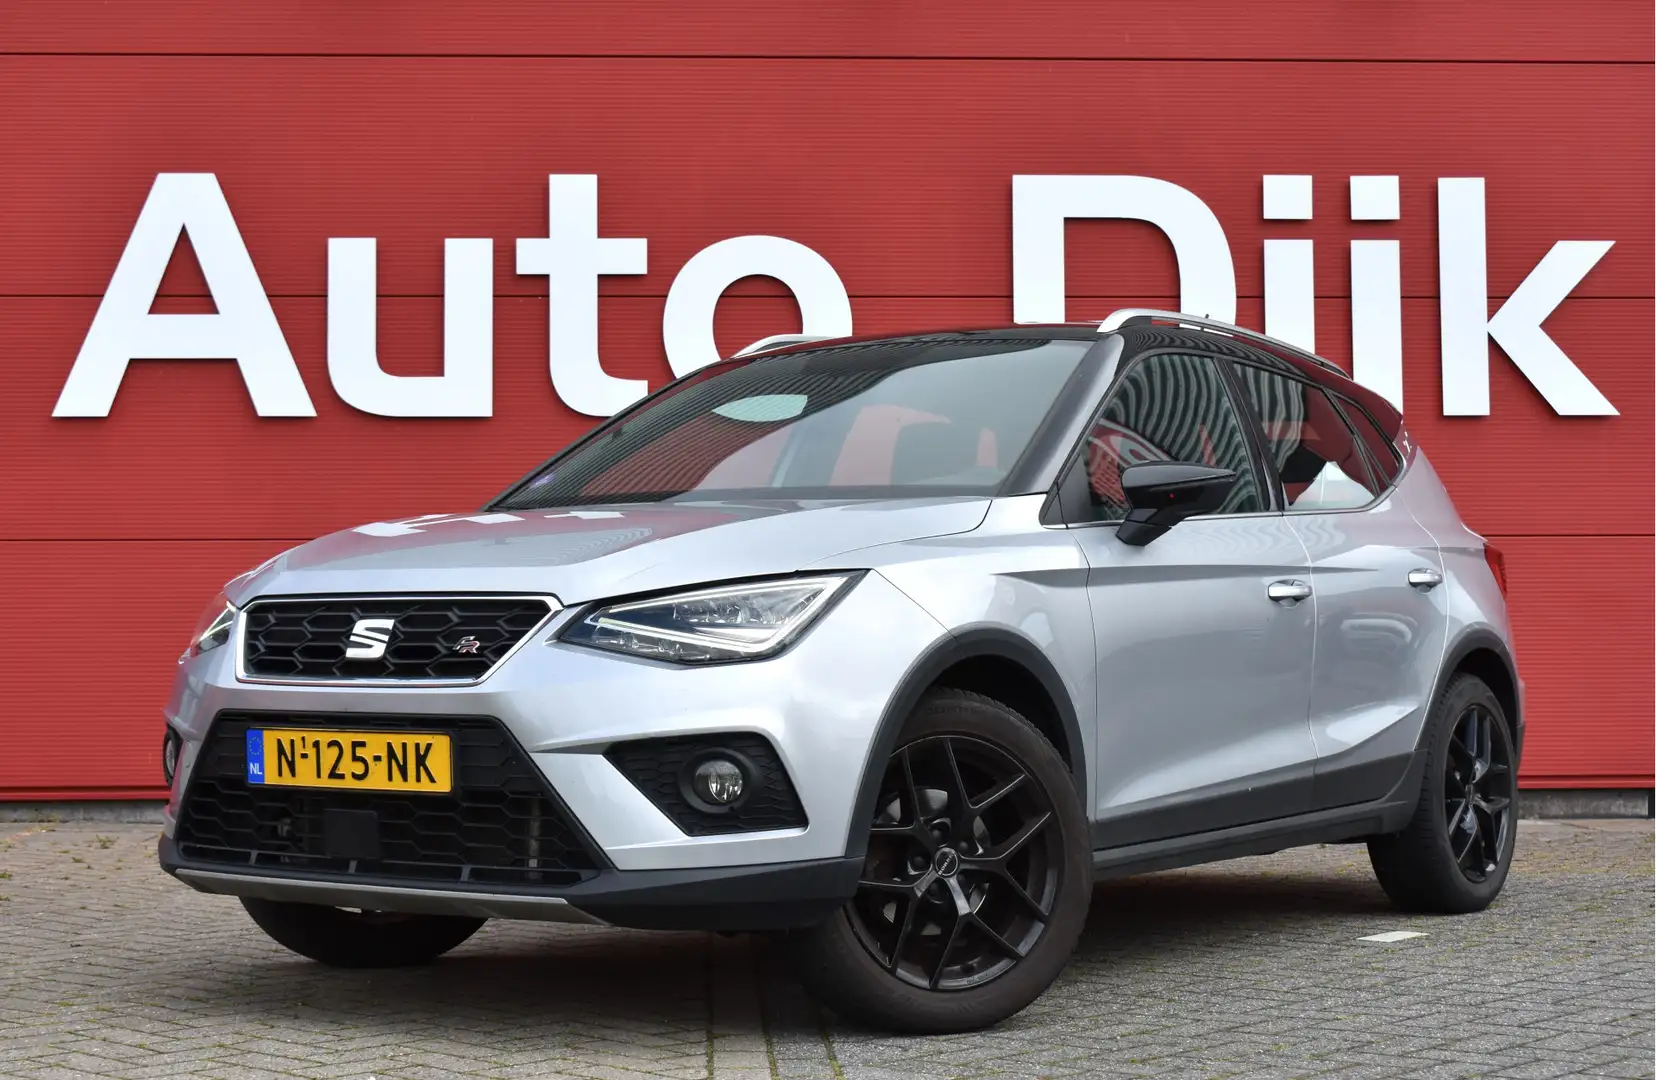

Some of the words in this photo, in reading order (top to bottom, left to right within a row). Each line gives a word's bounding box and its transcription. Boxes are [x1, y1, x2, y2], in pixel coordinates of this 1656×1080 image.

[52, 173, 852, 417] Auto
[1013, 175, 1620, 416] Dijk
[250, 763, 263, 775] NL
